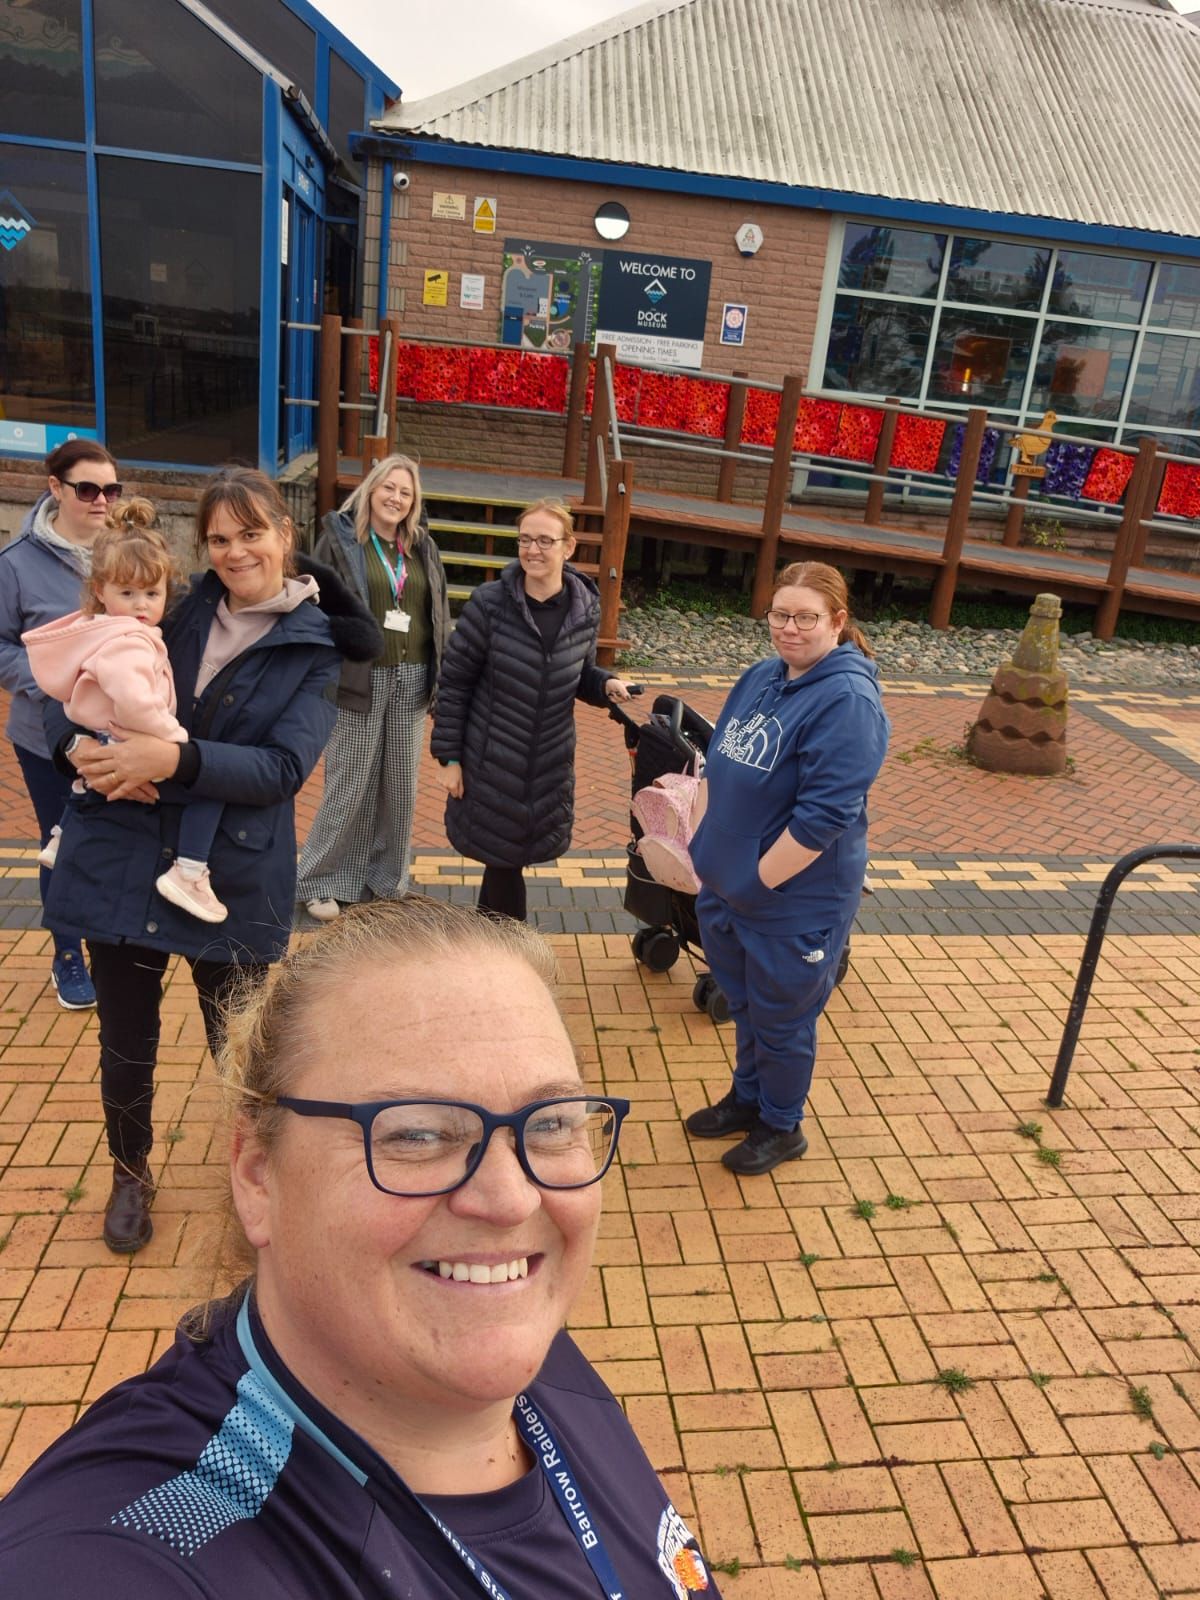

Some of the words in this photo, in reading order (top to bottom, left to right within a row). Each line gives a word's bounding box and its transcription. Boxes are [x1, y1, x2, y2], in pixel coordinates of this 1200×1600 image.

[619, 260, 678, 279] WELCOME
[679, 267, 696, 281] TO
[637, 309, 668, 323] DOCK
[637, 320, 667, 329] MUSEUM
[601, 333, 615, 341] FREE
[617, 334, 652, 345] ADMISSION
[656, 339, 671, 348] FREE
[671, 340, 698, 350] PARKING
[621, 343, 655, 355] OPENING
[657, 346, 678, 357] TIMES
[516, 1394, 561, 1469] Raiders
[555, 1471, 599, 1550] Barrow
